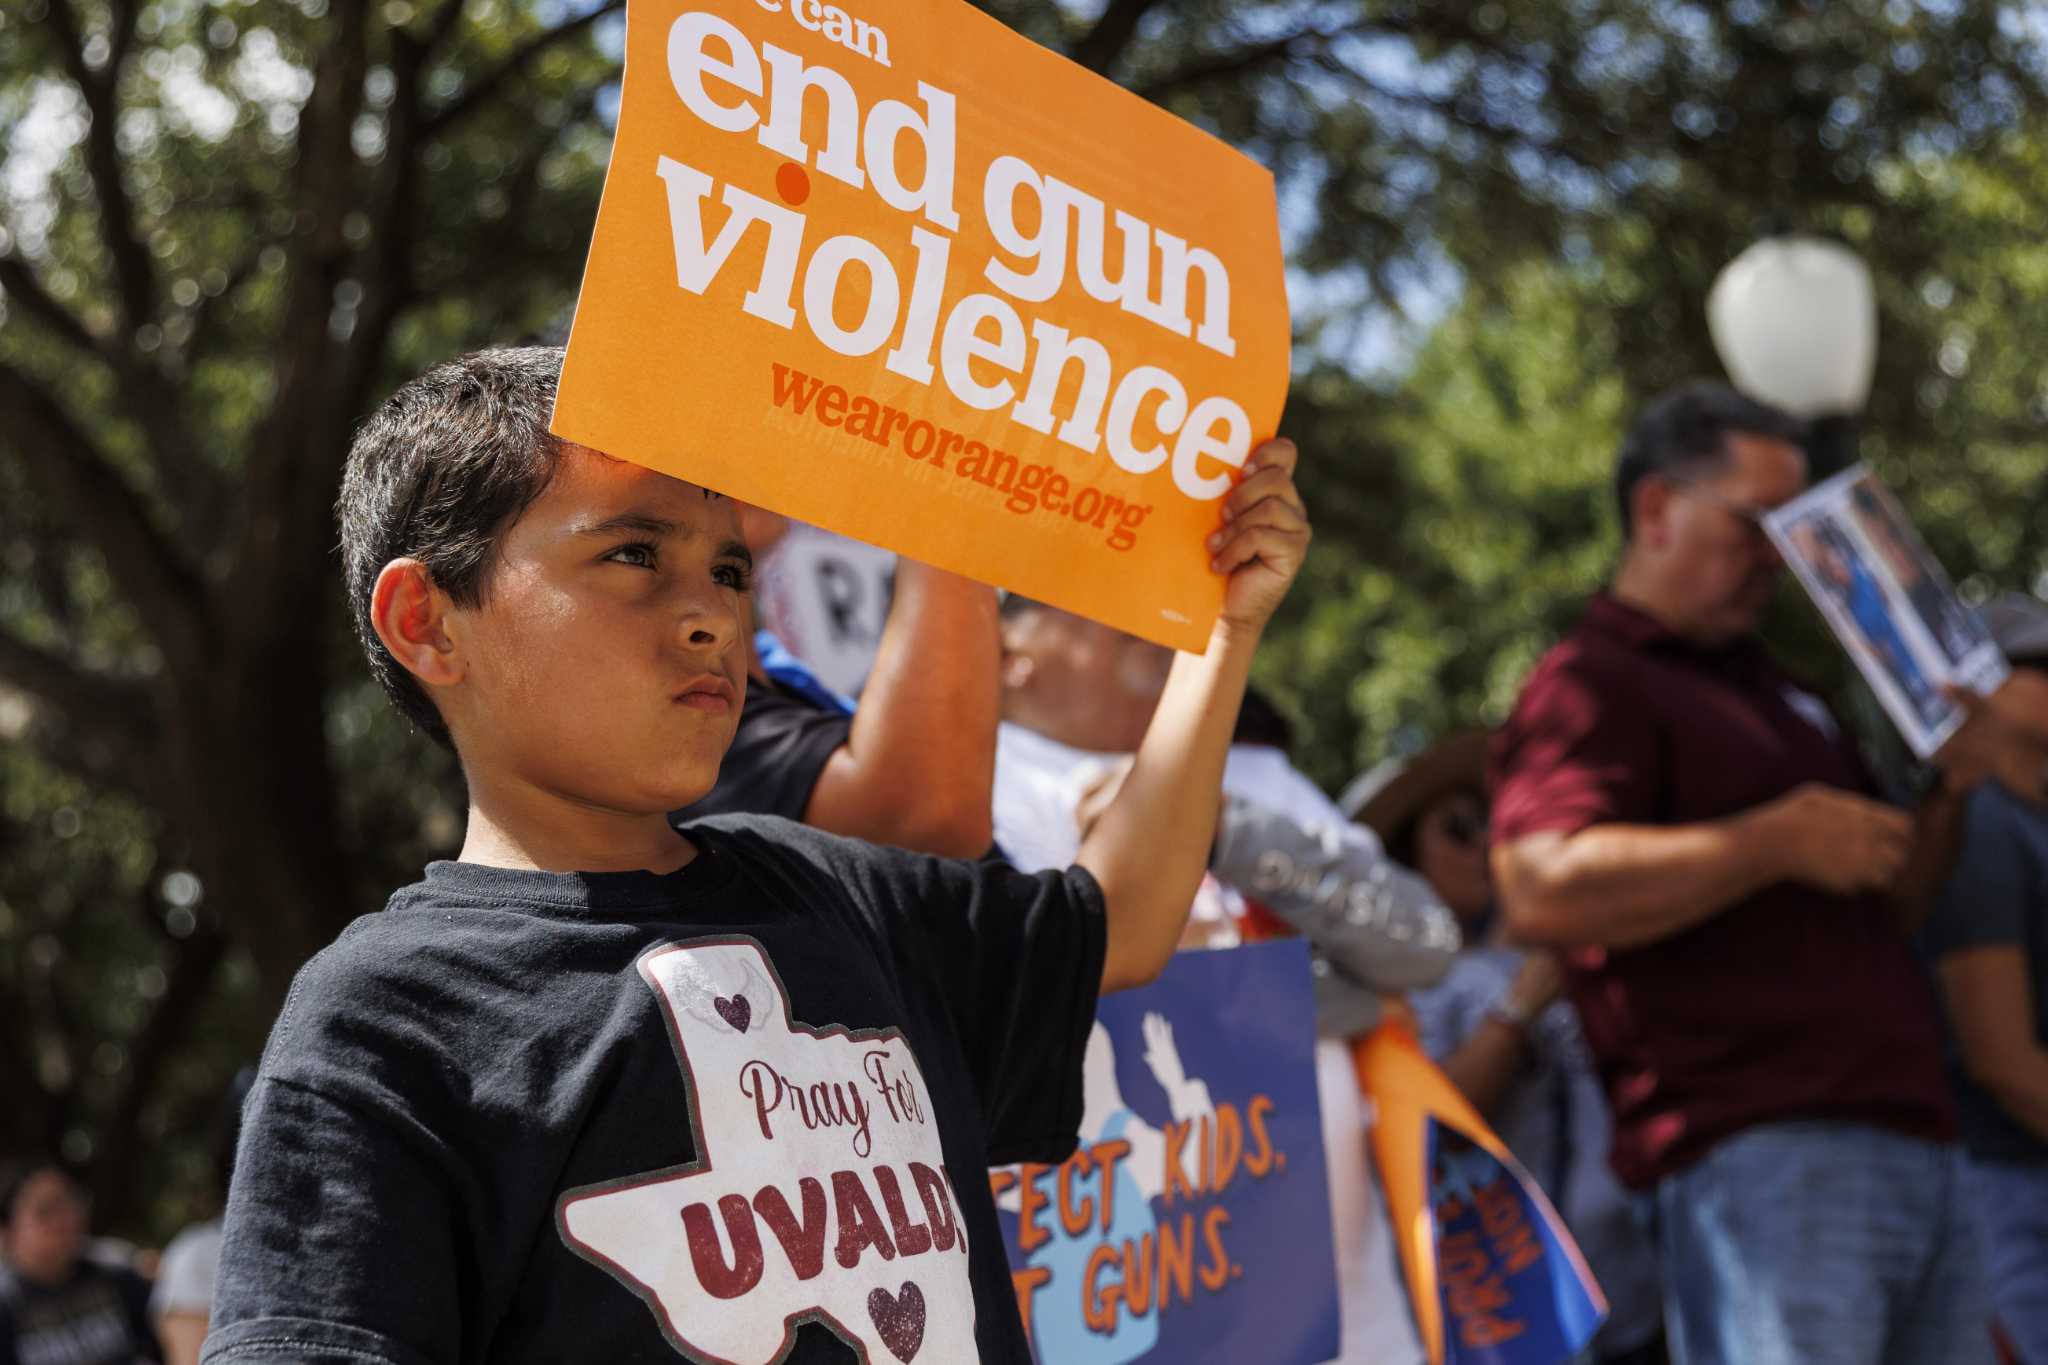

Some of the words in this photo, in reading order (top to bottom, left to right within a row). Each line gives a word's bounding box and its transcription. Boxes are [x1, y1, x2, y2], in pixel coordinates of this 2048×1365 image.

[790, 0, 892, 68] can
[666, 11, 961, 234] end
[983, 155, 1237, 358] gun
[655, 154, 1253, 501] violence
[771, 361, 1153, 553] wearorange.org
[739, 1060, 872, 1159] Pray
[863, 1050, 925, 1126] For
[1163, 1093, 1288, 1204] KIDS.
[680, 1161, 968, 1300] UVALD
[1083, 1207, 1242, 1335] GUNS.
